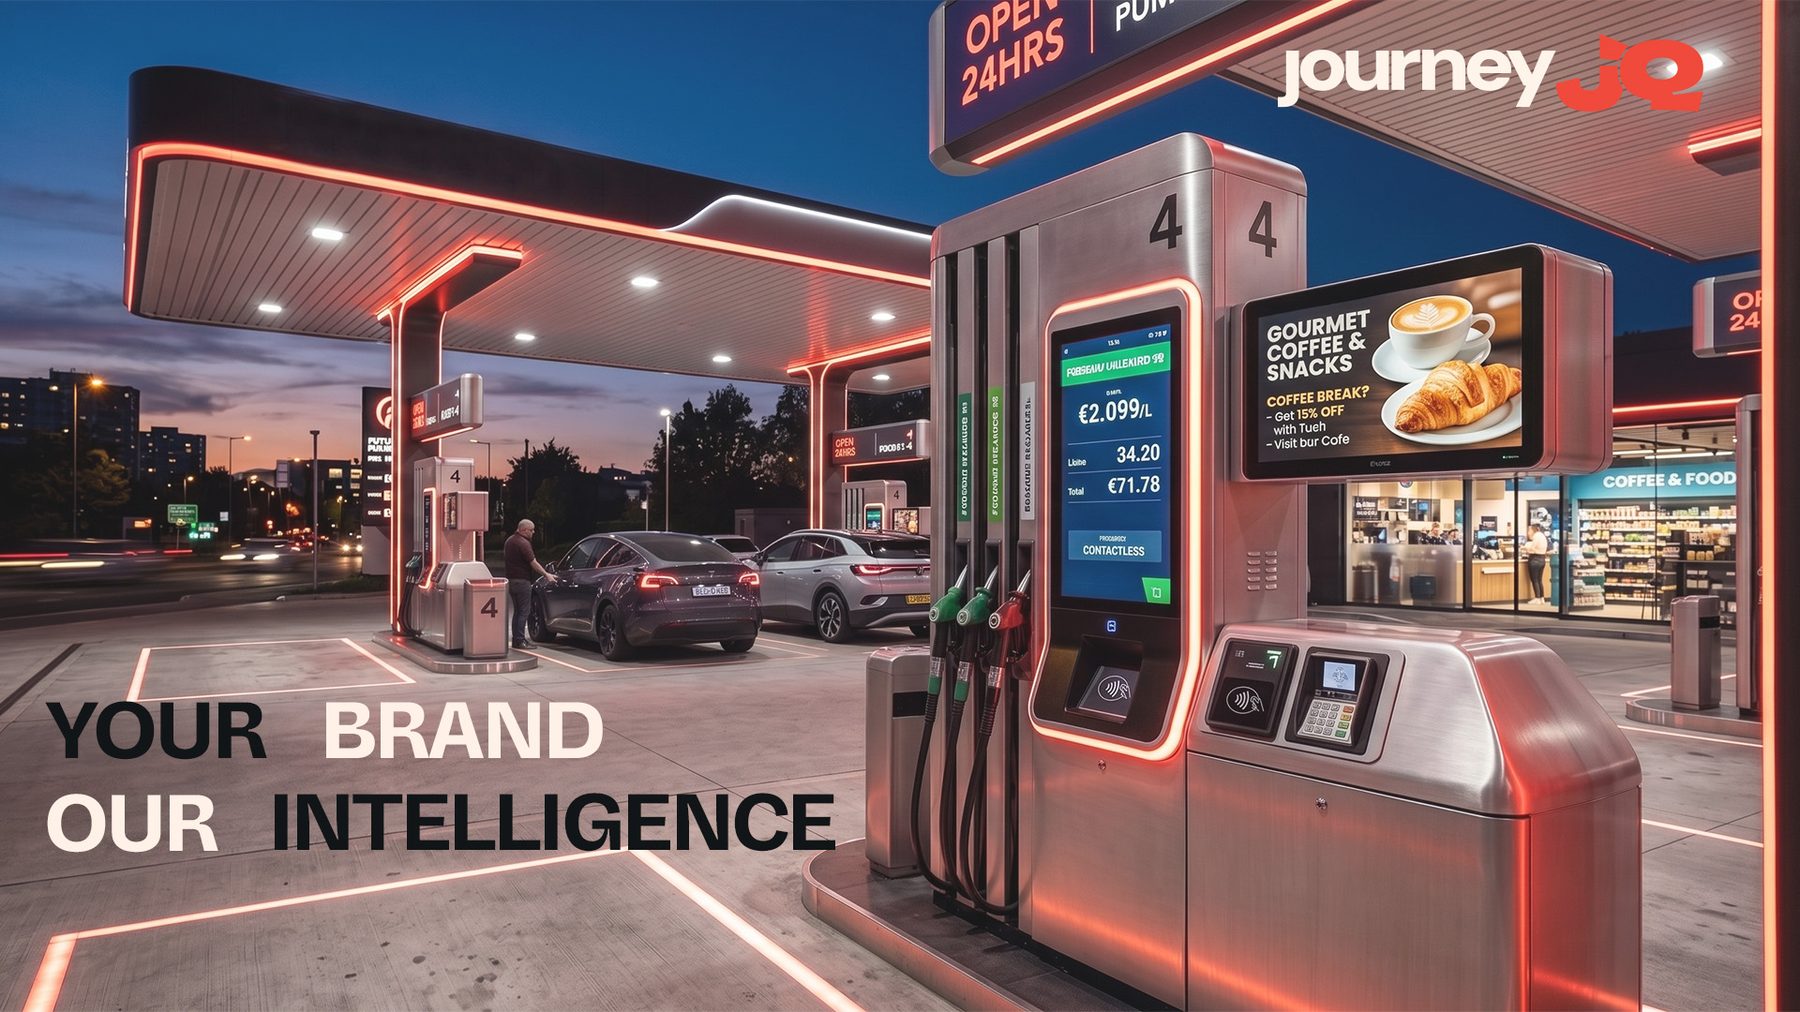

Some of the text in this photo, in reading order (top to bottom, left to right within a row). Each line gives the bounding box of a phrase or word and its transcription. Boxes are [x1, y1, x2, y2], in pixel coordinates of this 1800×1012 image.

[962, 17, 1064, 106] 24HRS
[1150, 193, 1183, 250] 4
[1249, 200, 1277, 259] 4
[1267, 309, 1370, 343] GOURMET
[1267, 331, 1367, 362] COFFEE &
[1267, 354, 1353, 381] SNACKS
[1266, 385, 1370, 408] COFFEE BREAK?
[1079, 398, 1152, 424] €2.099/L
[1275, 410, 1296, 422] Get
[1297, 407, 1318, 420] 15%
[1321, 404, 1345, 418] OFF
[1273, 423, 1297, 436] with
[1274, 437, 1298, 450] Visit
[1300, 437, 1320, 448] bur
[1321, 433, 1350, 447] Cofe
[1117, 443, 1161, 463] 34.20
[450, 469, 461, 483] 4
[1067, 475, 1161, 496] Total €71.78
[1603, 471, 1737, 489] COFFEE & FOOD
[893, 490, 900, 500] 4
[1082, 545, 1145, 557] CONTACTLESS
[480, 597, 498, 618] 4
